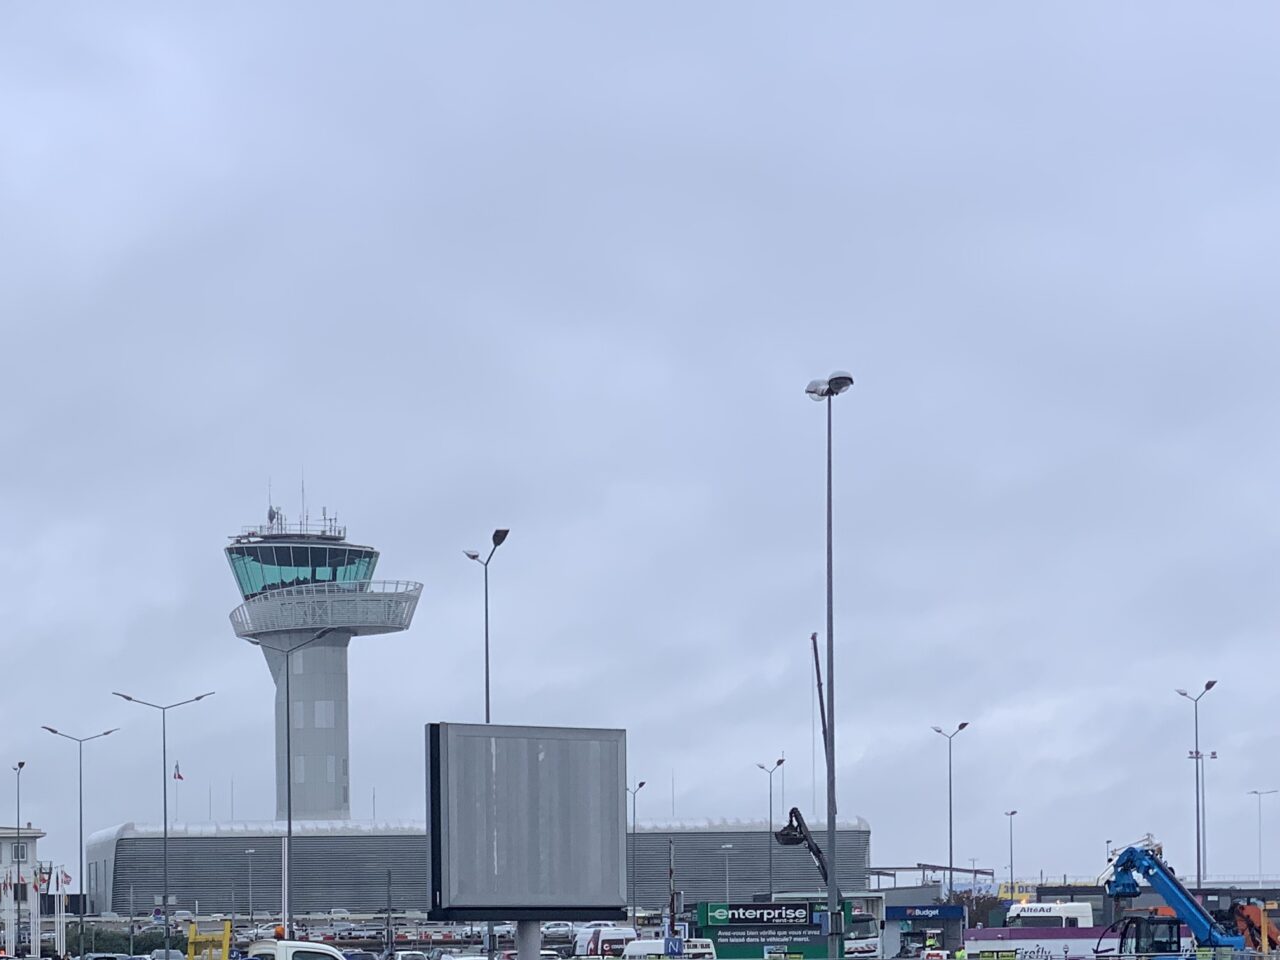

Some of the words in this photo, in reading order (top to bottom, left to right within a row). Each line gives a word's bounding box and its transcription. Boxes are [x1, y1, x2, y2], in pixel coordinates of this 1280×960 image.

[714, 907, 807, 922] enterprise
[915, 909, 939, 918] Budget
[668, 941, 679, 952] N
[1015, 946, 1052, 960] Firefly
